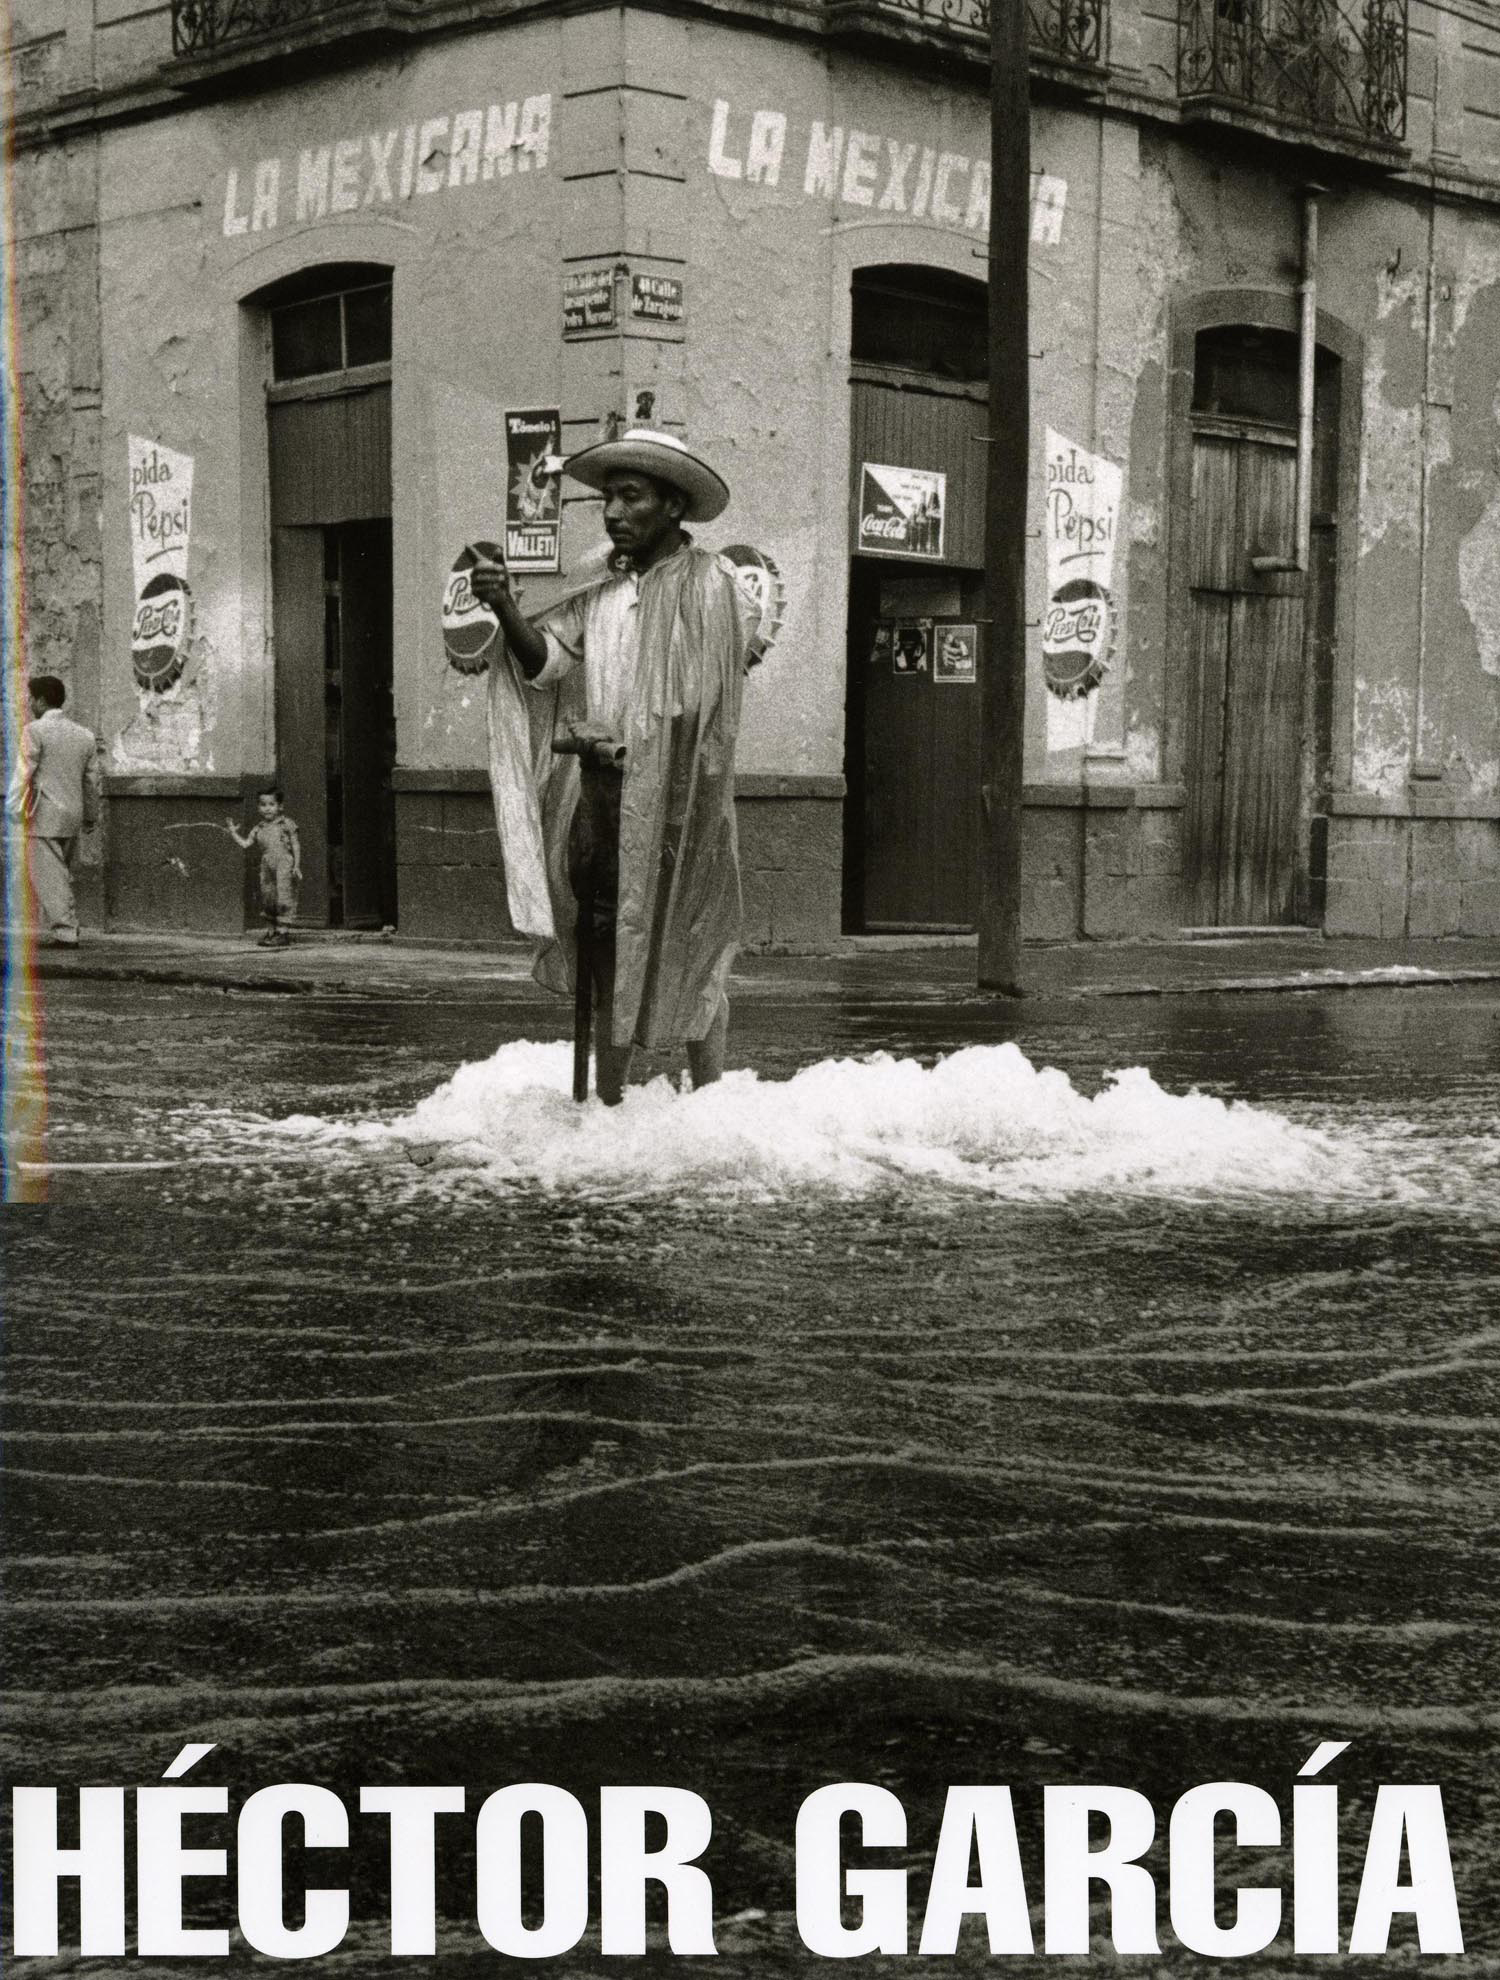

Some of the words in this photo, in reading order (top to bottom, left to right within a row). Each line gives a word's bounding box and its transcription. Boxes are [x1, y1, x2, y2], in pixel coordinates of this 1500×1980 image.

[223, 158, 281, 236] LA
[297, 93, 551, 222] MEXICANA
[708, 99, 787, 187] LA
[803, 121, 1068, 244] MEXICAA
[132, 450, 173, 494] pida
[1047, 449, 1095, 489] pida
[130, 491, 188, 549] Pepsi
[1046, 488, 1113, 551] Pepsi
